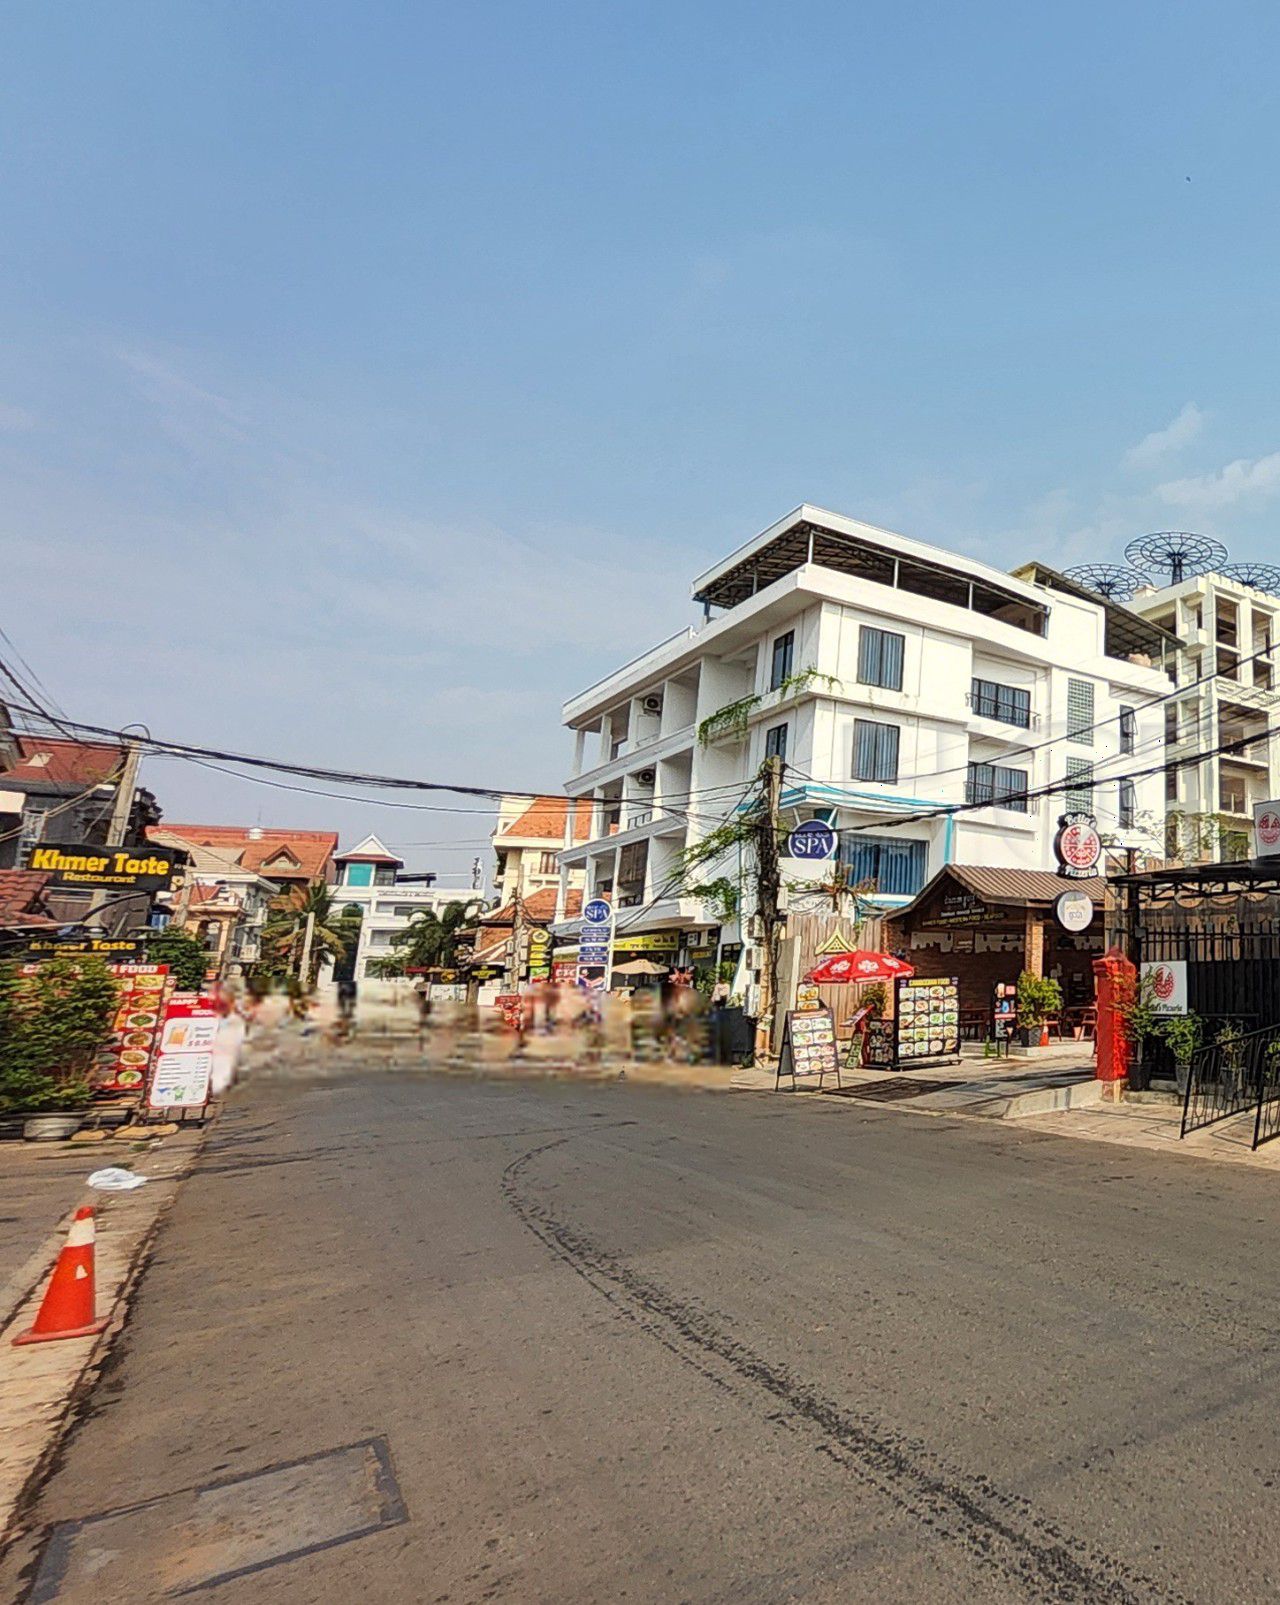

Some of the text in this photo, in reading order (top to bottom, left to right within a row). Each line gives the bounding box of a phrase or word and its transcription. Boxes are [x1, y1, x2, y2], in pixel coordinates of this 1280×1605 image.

[1064, 812, 1097, 829] Bella's
[793, 837, 829, 854] SPA
[32, 848, 169, 876] Khmer Taste
[62, 871, 136, 884] Restaurant
[586, 907, 608, 919] SPA
[91, 939, 137, 951] Taste
[120, 964, 159, 974] FOOD
